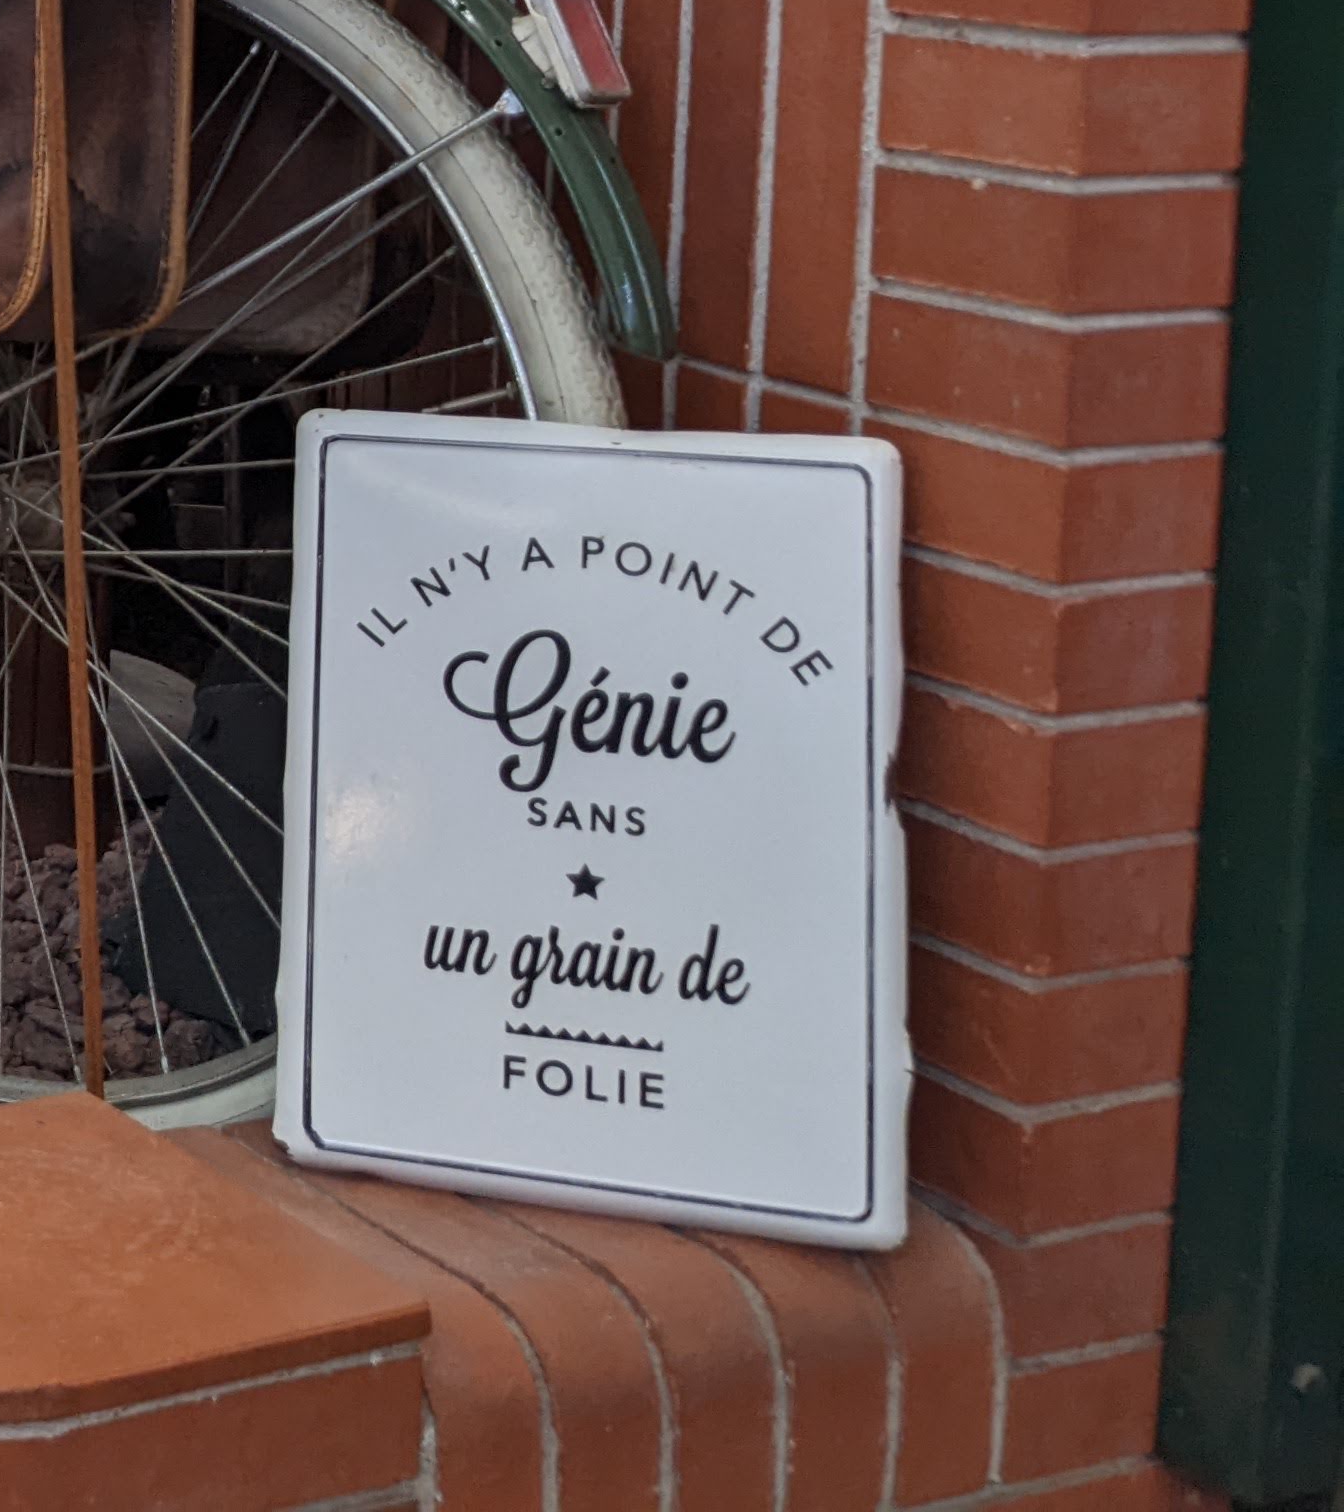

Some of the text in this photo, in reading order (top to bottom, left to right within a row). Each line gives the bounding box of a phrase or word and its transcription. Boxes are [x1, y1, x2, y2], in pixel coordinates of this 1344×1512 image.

[356, 535, 834, 687] IL N'Y A POINT DE
[442, 628, 737, 792] Génie
[526, 797, 647, 837] SANS
[422, 922, 750, 1007] un grain de
[502, 1054, 665, 1110] FOLIE
